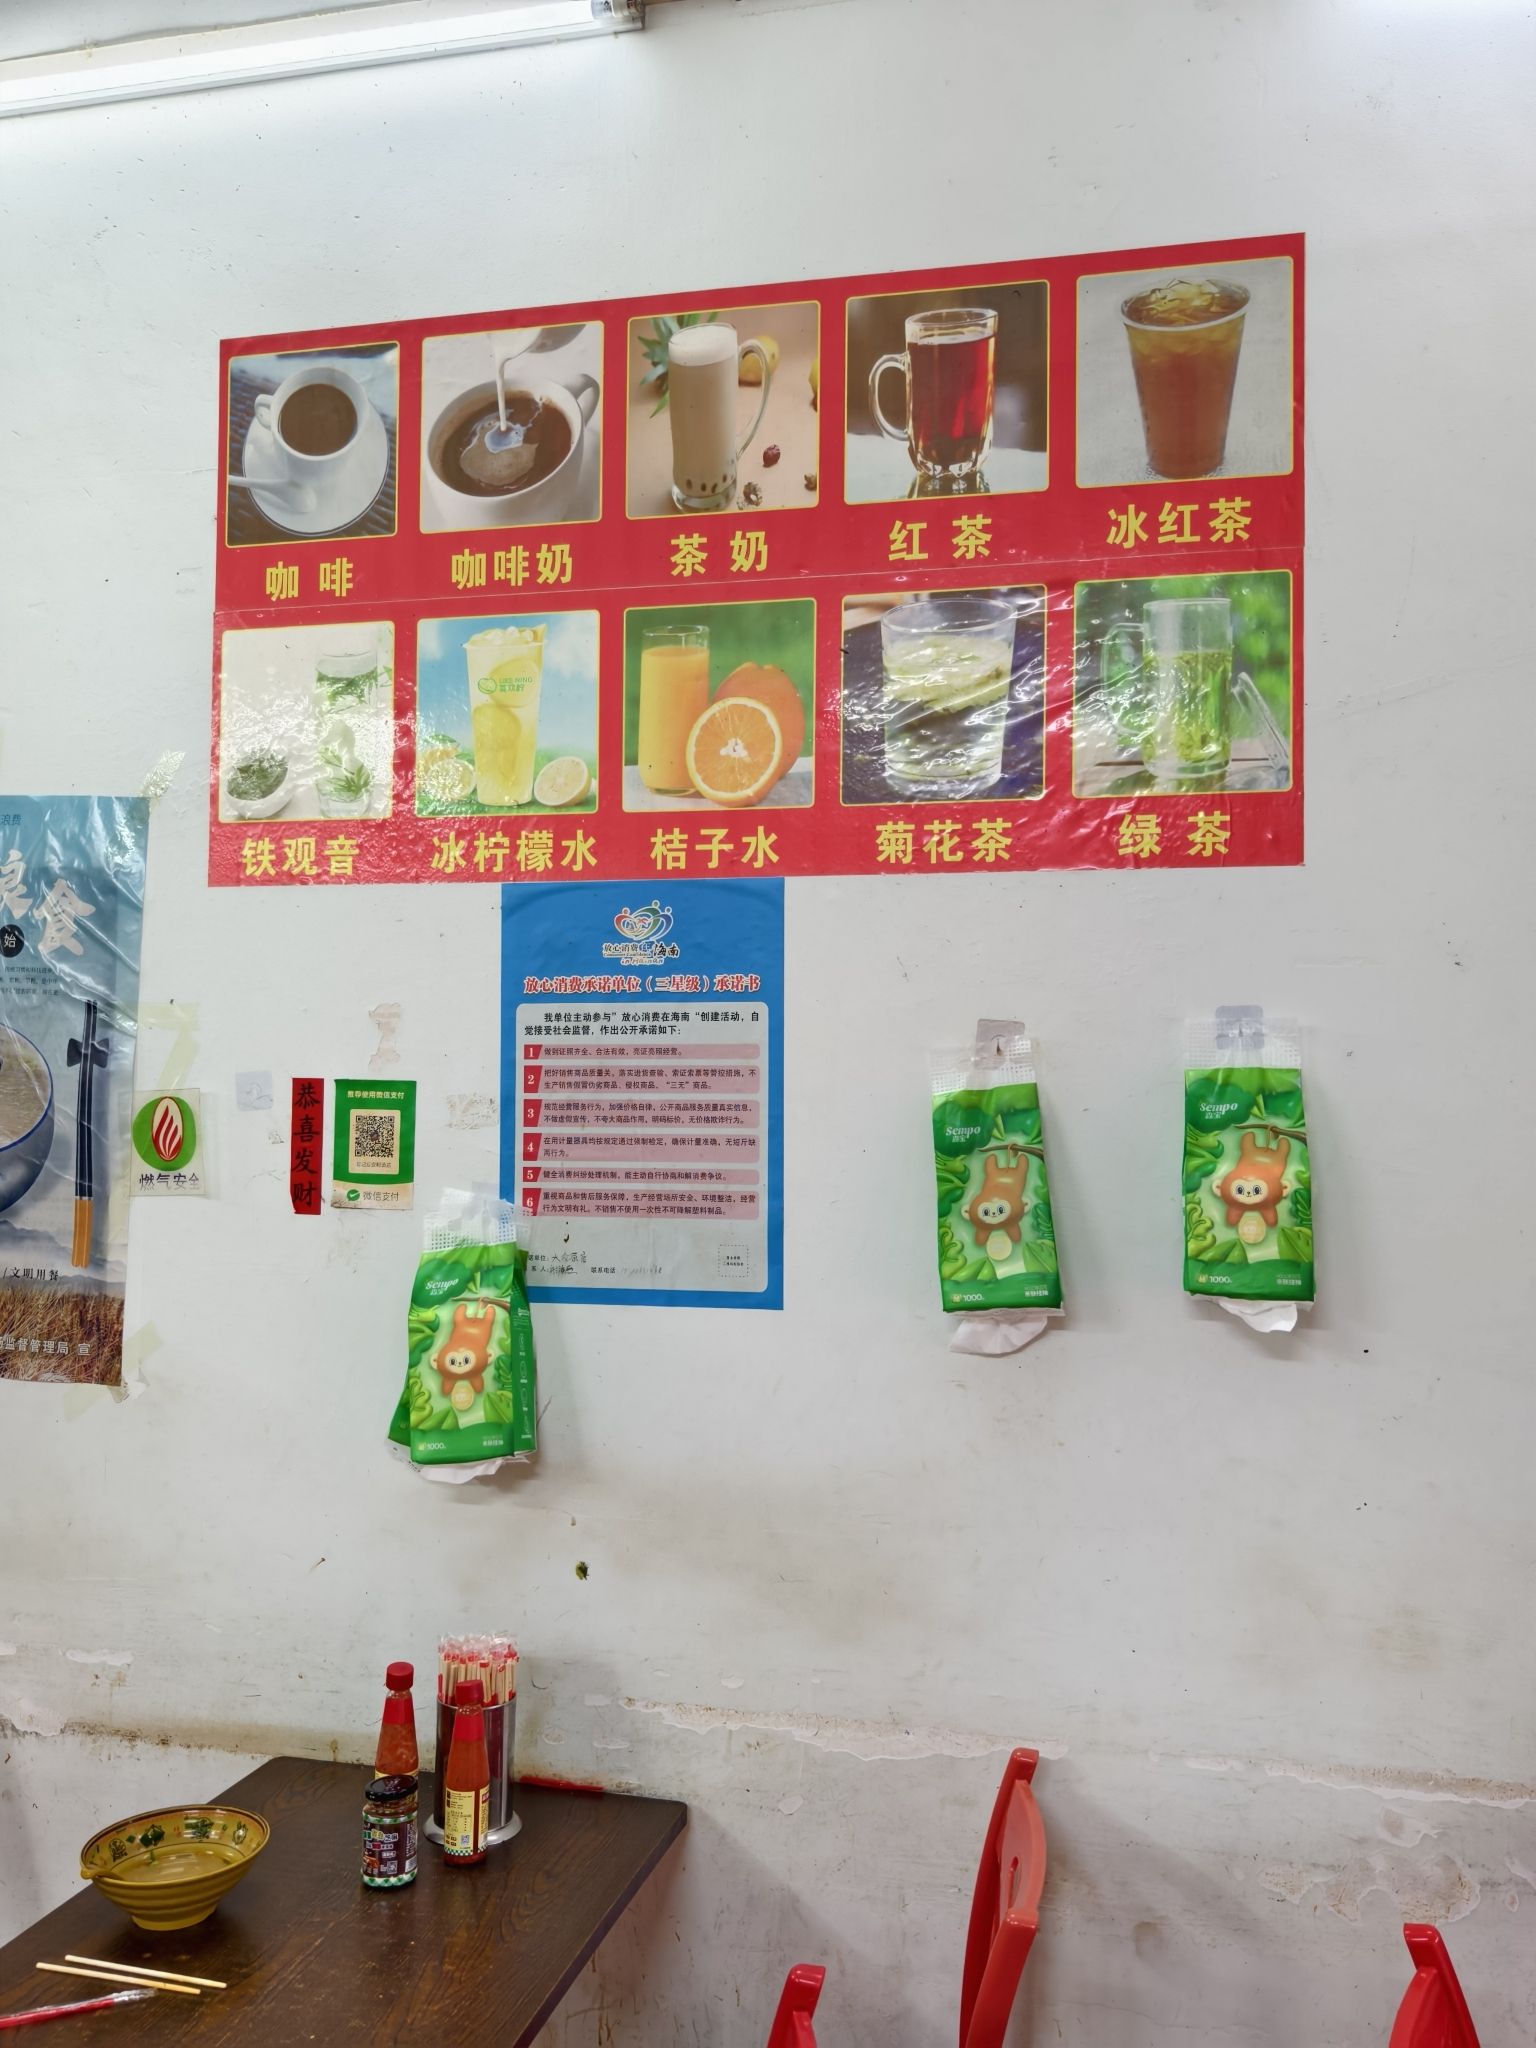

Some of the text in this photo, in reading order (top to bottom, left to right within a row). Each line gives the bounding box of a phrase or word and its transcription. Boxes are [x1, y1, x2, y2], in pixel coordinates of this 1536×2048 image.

[1106, 496, 1252, 549] 冰红茶
[888, 514, 993, 562] 红茶
[670, 531, 769, 578] 茶奶
[451, 542, 573, 590] 咖啡奶
[265, 556, 354, 602] 咖啡
[875, 818, 1013, 865] 菊花茶
[1118, 810, 1232, 858] 绿茶
[242, 834, 359, 877] 铁观音
[432, 829, 598, 874] 冰柠檬水
[650, 825, 780, 871] 桔子水
[4, 932, 17, 948] 始
[524, 974, 760, 994] 放心消费承诺单位（三星级）承诺书
[528, 1047, 535, 1058] 1
[527, 1074, 535, 1085] 2
[527, 1108, 534, 1119] 3
[1199, 1103, 1238, 1115] Sempo
[945, 1126, 981, 1139] Sempo
[291, 1081, 320, 1207] 恭喜发财
[527, 1141, 534, 1153] 4
[139, 1172, 199, 1191] 燃气安全
[526, 1170, 534, 1180] 5
[363, 1190, 400, 1201] 微信支付
[526, 1197, 534, 1208] 6
[77, 1342, 91, 1356] 宣
